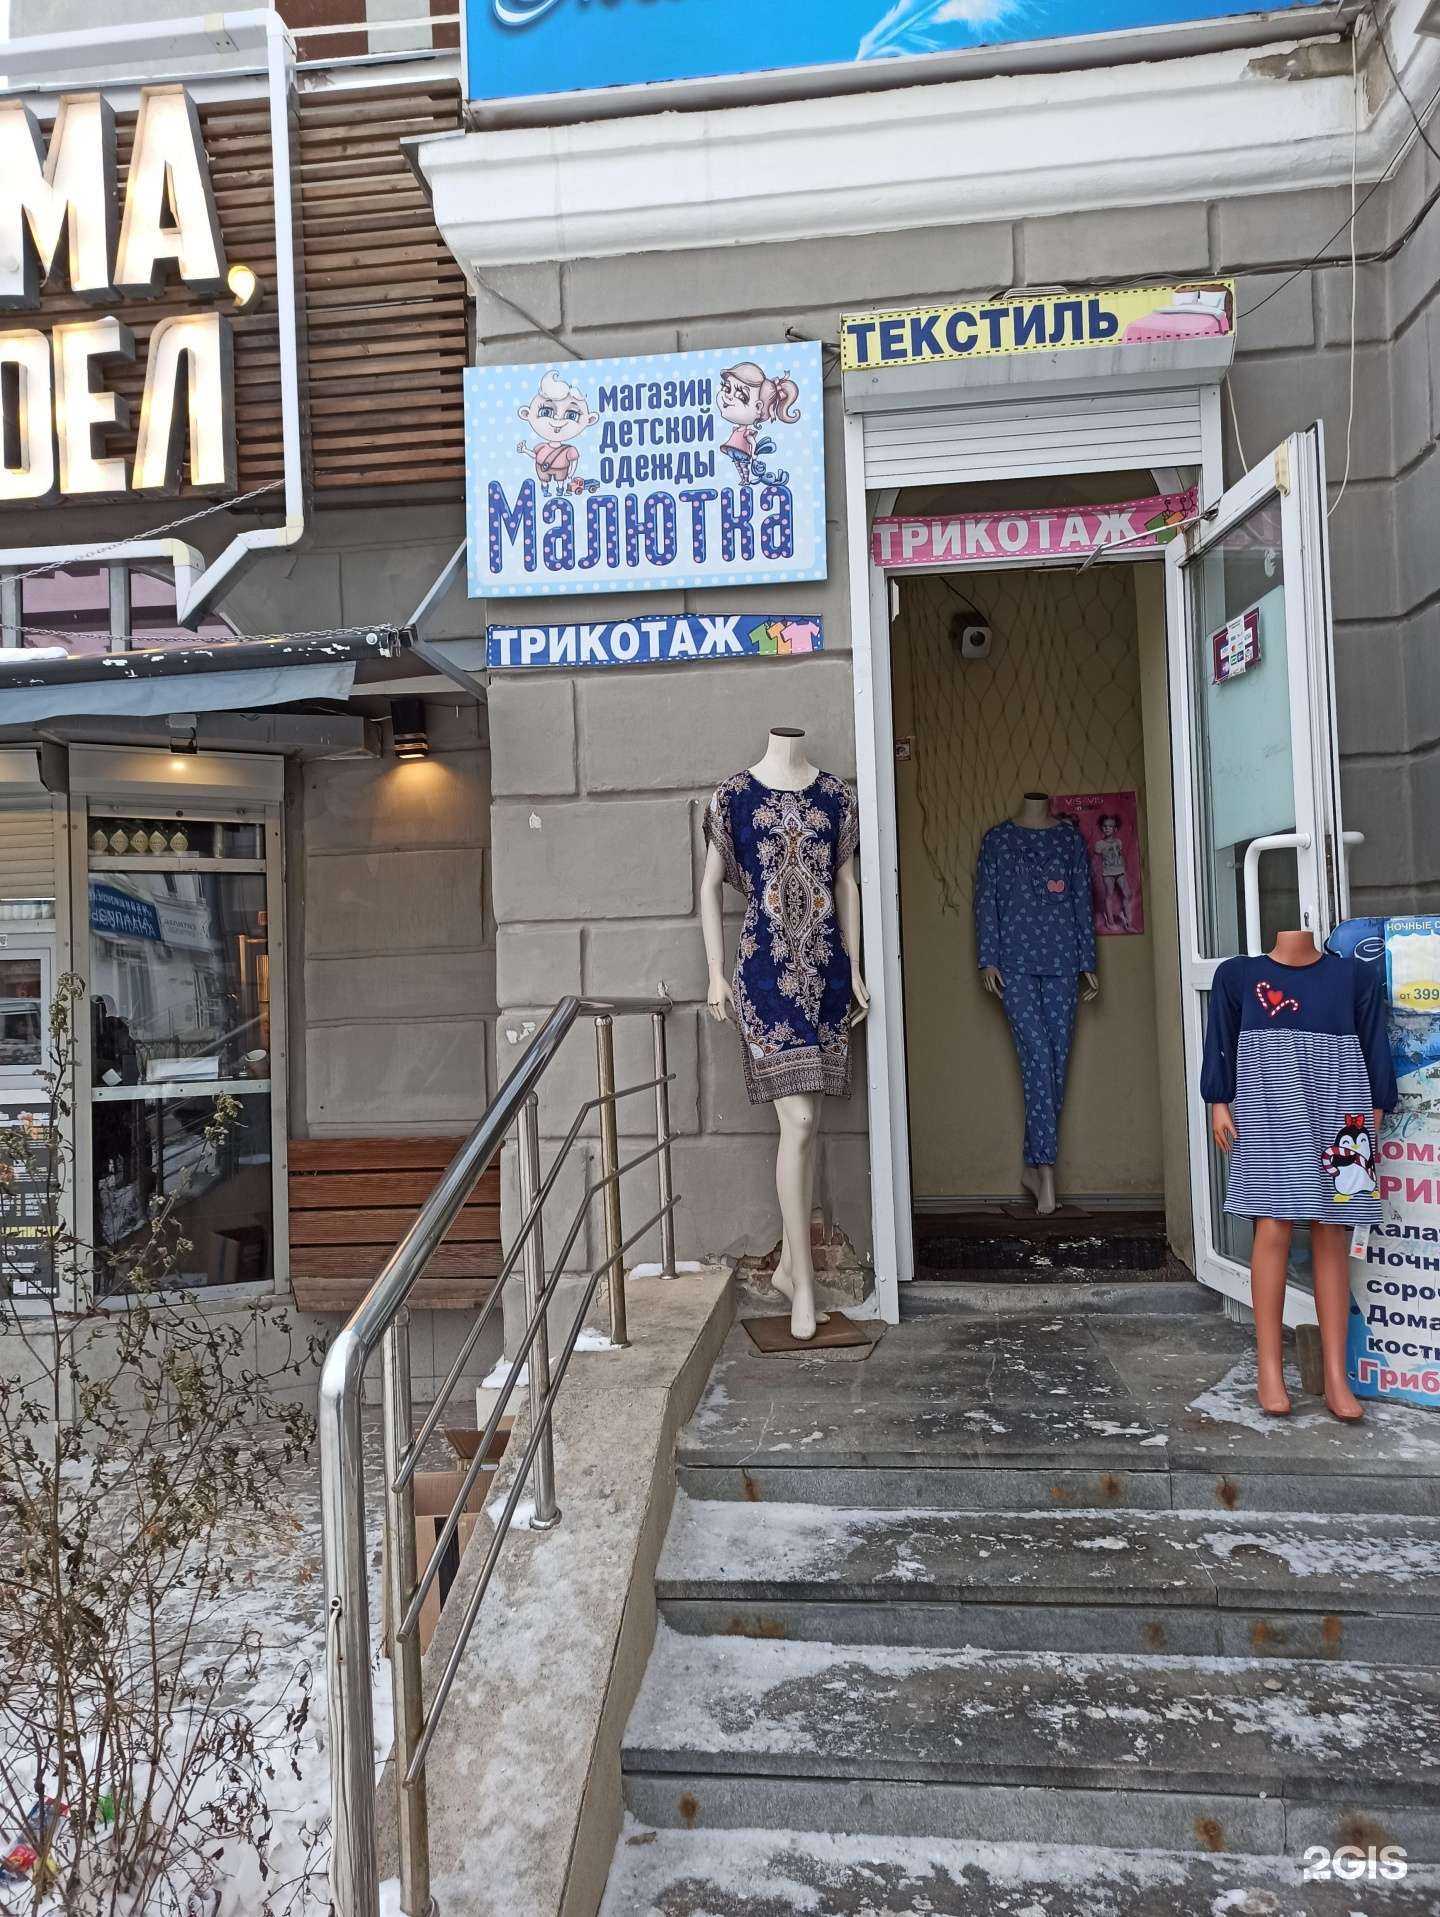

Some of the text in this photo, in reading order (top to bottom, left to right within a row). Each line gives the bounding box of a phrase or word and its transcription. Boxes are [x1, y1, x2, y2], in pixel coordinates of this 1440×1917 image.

[846, 298, 1119, 363] ТЕКСТИЛЬ
[598, 378, 712, 413] магазин
[599, 409, 715, 454] детской
[600, 450, 715, 488] одежды
[487, 478, 795, 574] Малютка
[872, 508, 1138, 560] ТРИКОТАЖ
[492, 615, 746, 667] ТРИКОТАЖ
[1386, 921, 1432, 931] НОЧНЫЕ
[1414, 988, 1440, 1000] 399
[1375, 1141, 1440, 1164] ом
[1380, 1175, 1440, 1204] РИ
[1370, 1223, 1440, 1242] Хала
[1366, 1246, 1440, 1271] Ночн
[1366, 1280, 1440, 1301] соро
[1360, 1360, 1440, 1393] Гриб
